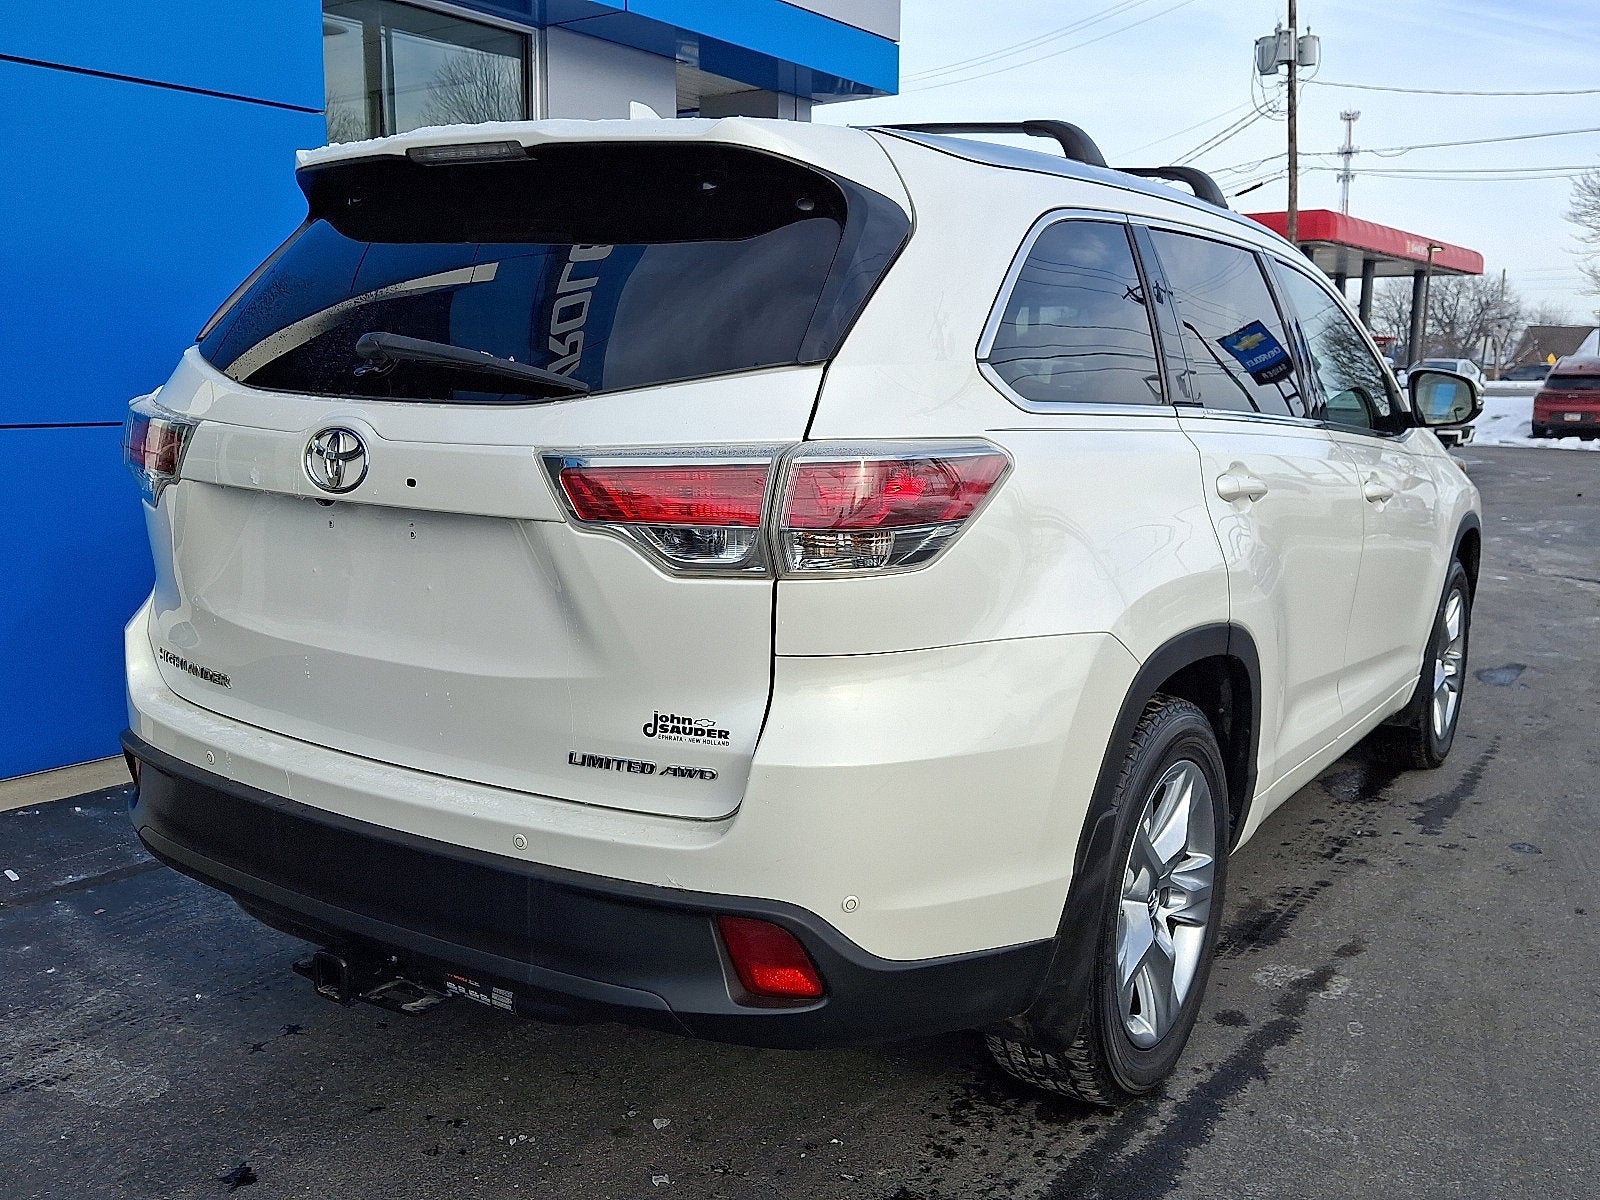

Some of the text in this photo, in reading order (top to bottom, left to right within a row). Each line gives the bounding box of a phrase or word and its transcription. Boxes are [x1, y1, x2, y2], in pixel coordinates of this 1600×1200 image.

[657, 733, 684, 743] EPHRATA
[702, 738, 730, 747] HOLLAND
[658, 724, 731, 740] SAUDER
[567, 750, 719, 781] LIMITED AWD
